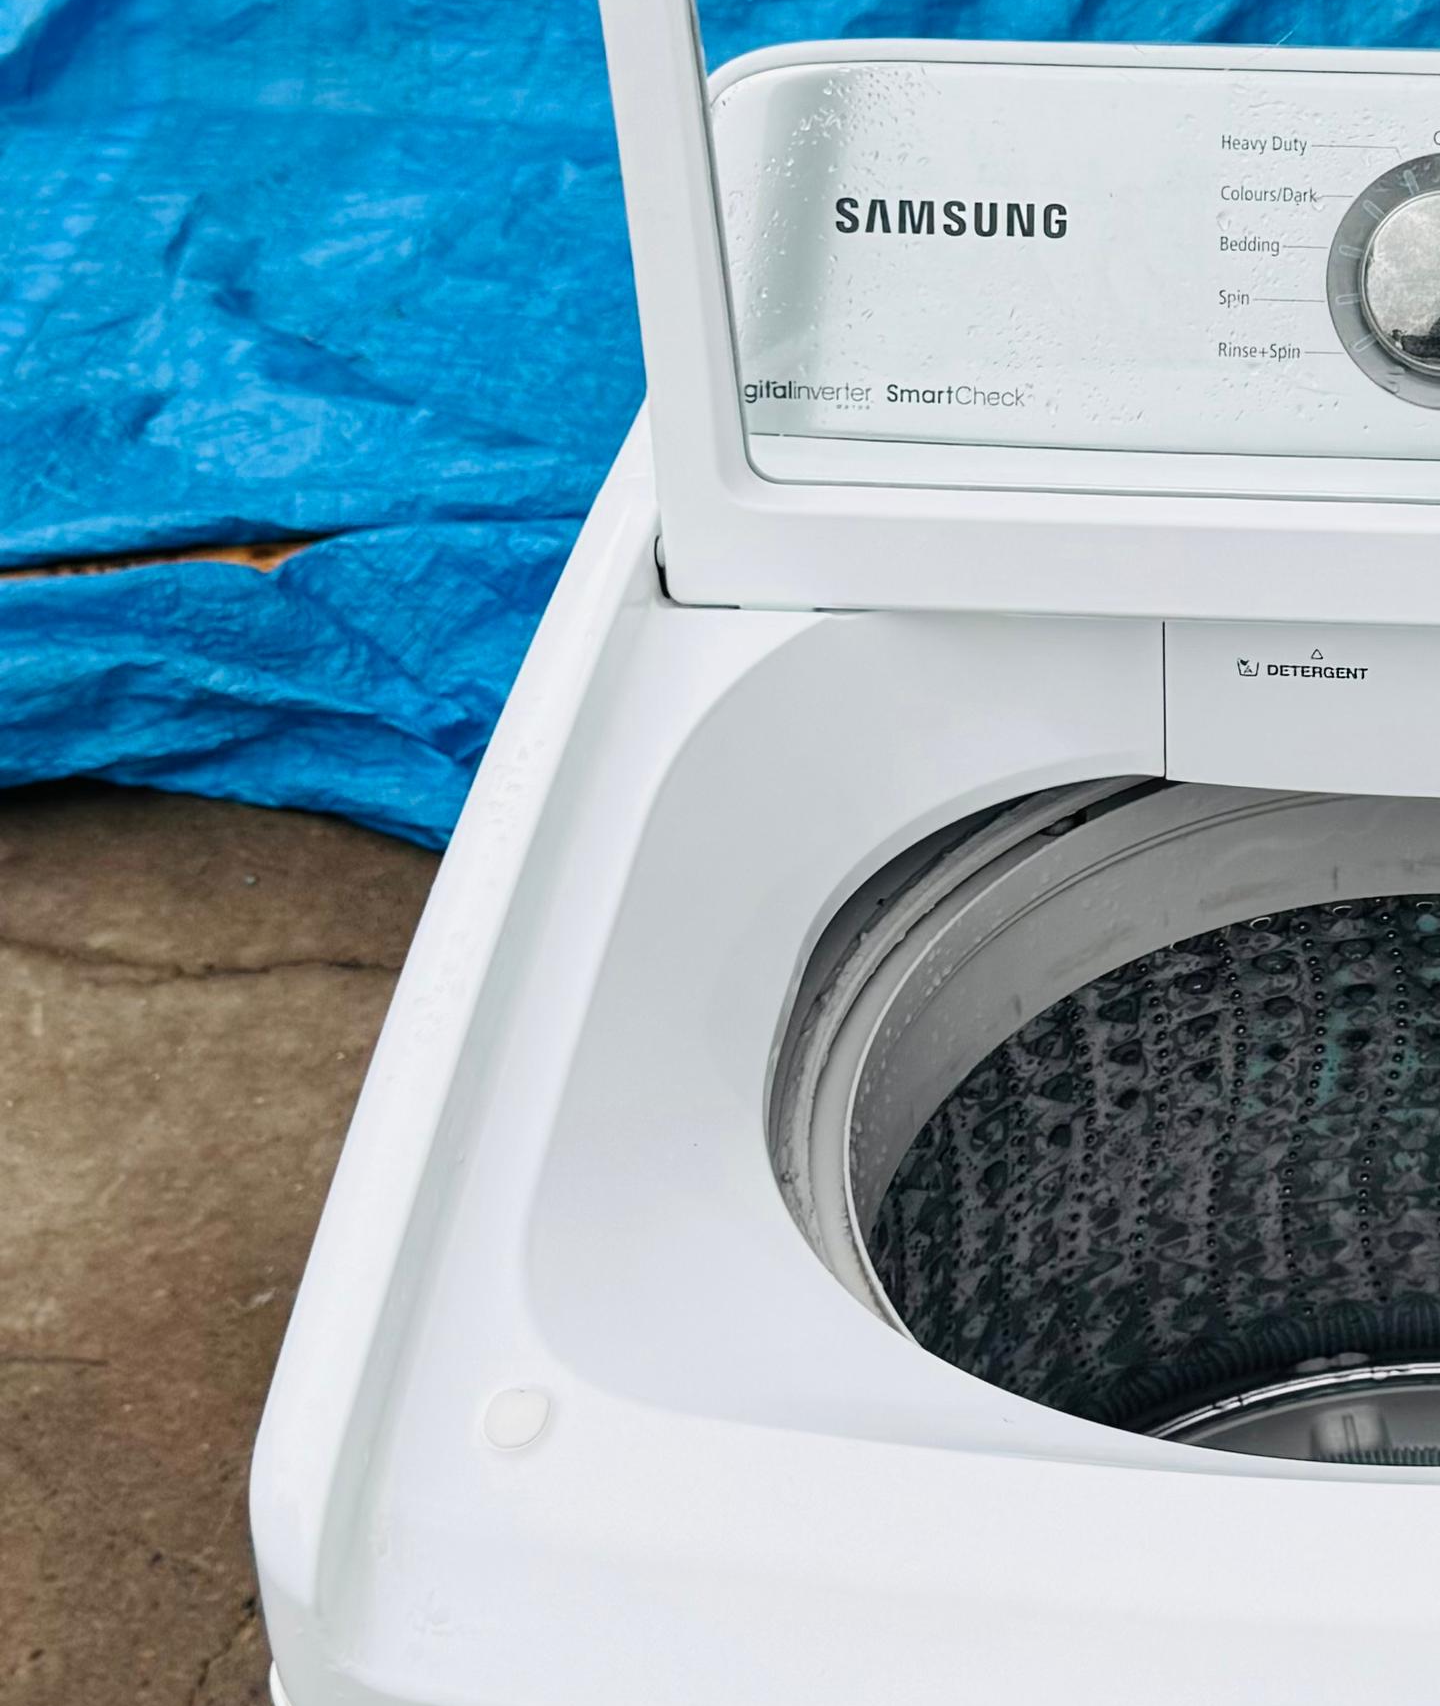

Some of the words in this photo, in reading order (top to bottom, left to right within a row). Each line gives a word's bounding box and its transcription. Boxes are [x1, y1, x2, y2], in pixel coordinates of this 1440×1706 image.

[1221, 134, 1267, 155] Heavy
[1272, 135, 1308, 156] Duty
[1220, 185, 1318, 203] Colours/Dark
[835, 196, 1068, 239] SAMSUNG
[1220, 236, 1280, 257] Bedding
[1219, 290, 1250, 306] Spin
[1218, 342, 1301, 359] Rinse+Spin
[1267, 663, 1369, 680] DETERGENT
